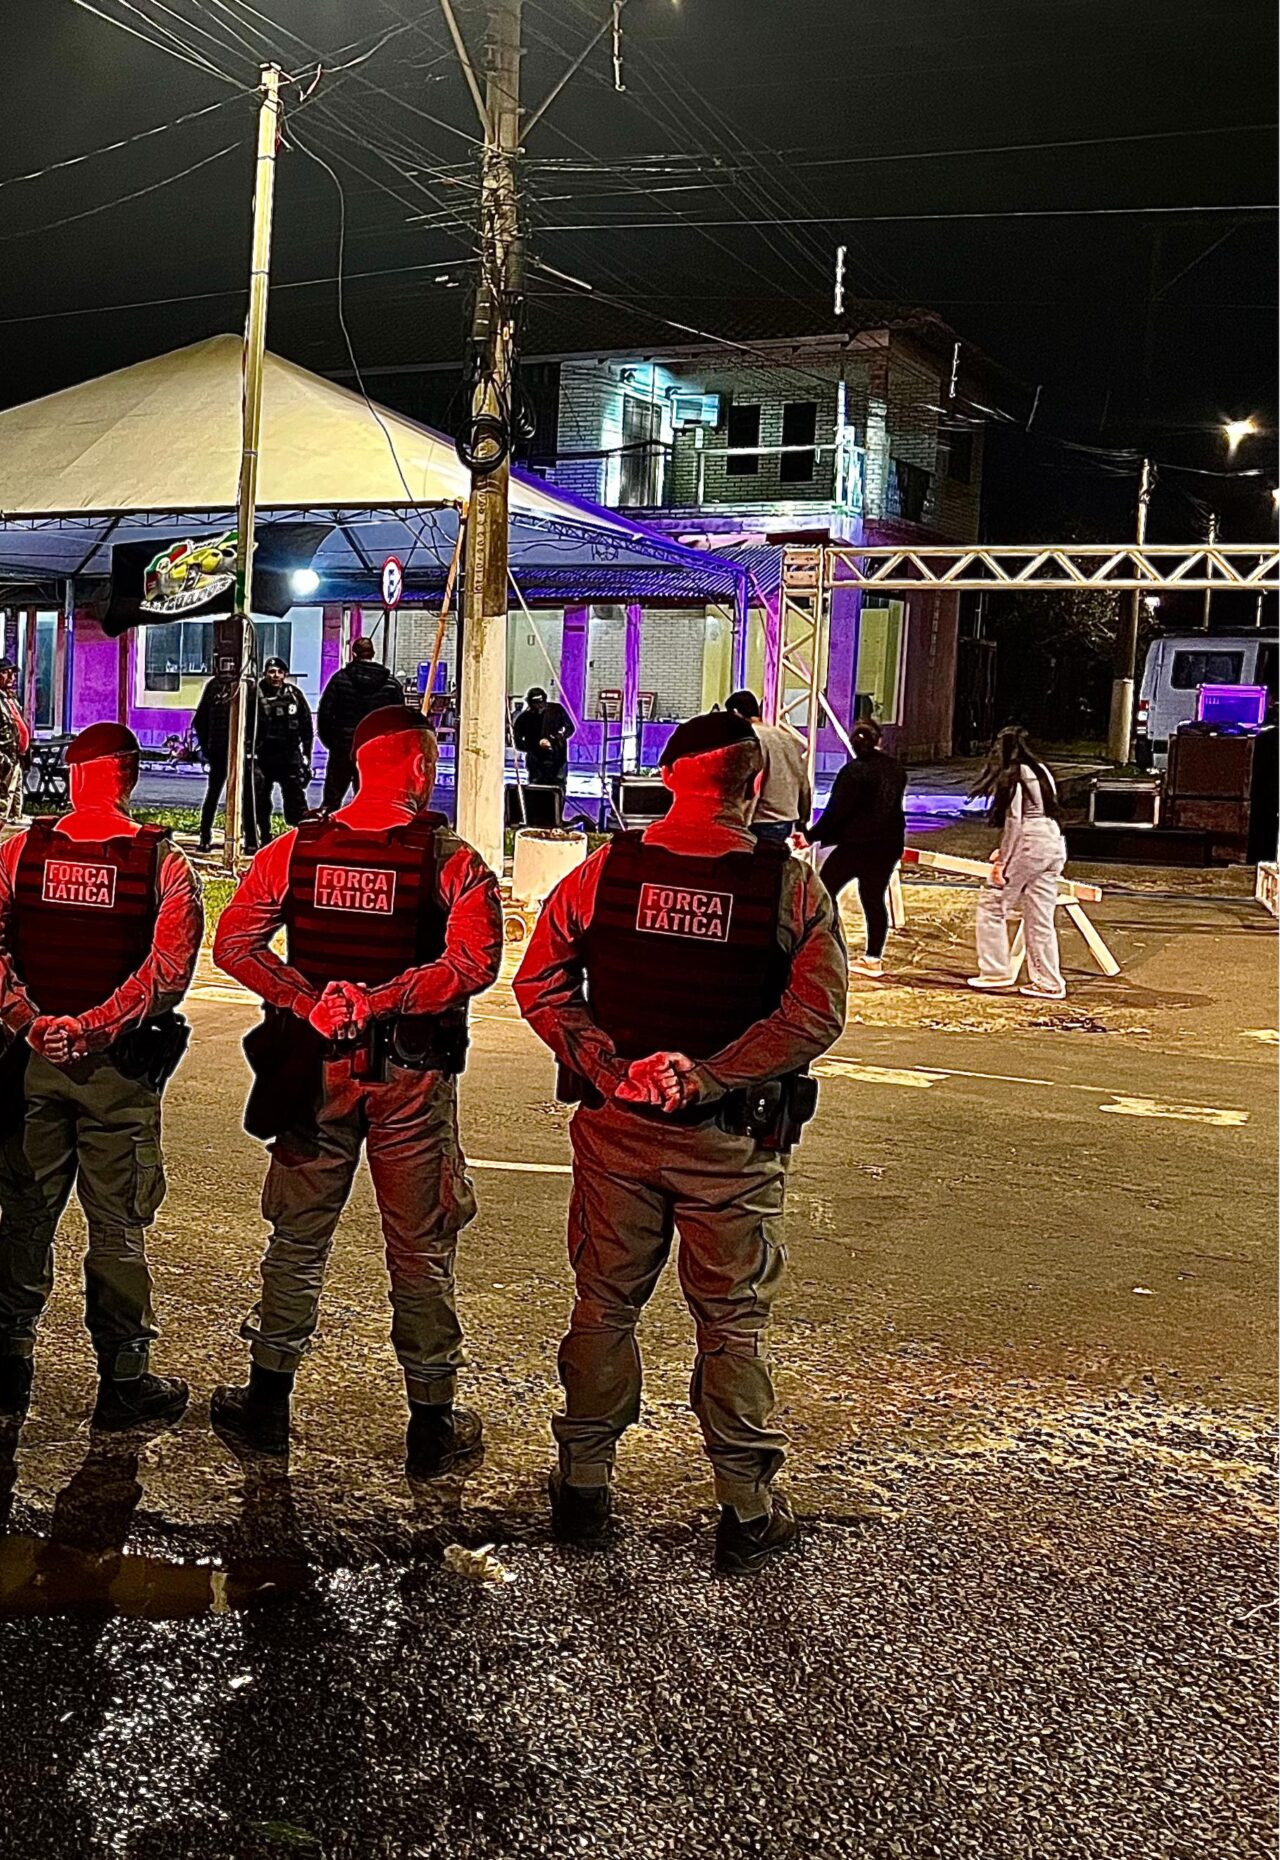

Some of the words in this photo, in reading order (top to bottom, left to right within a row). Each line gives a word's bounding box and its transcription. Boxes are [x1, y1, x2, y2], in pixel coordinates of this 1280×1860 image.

[49, 865, 109, 886] FORÇA
[322, 870, 387, 892] FORÇA
[47, 882, 109, 903] TÁTICA
[318, 888, 388, 910] TÁTICA
[647, 889, 722, 915] FORÇA
[643, 909, 722, 936] TÁTICA
